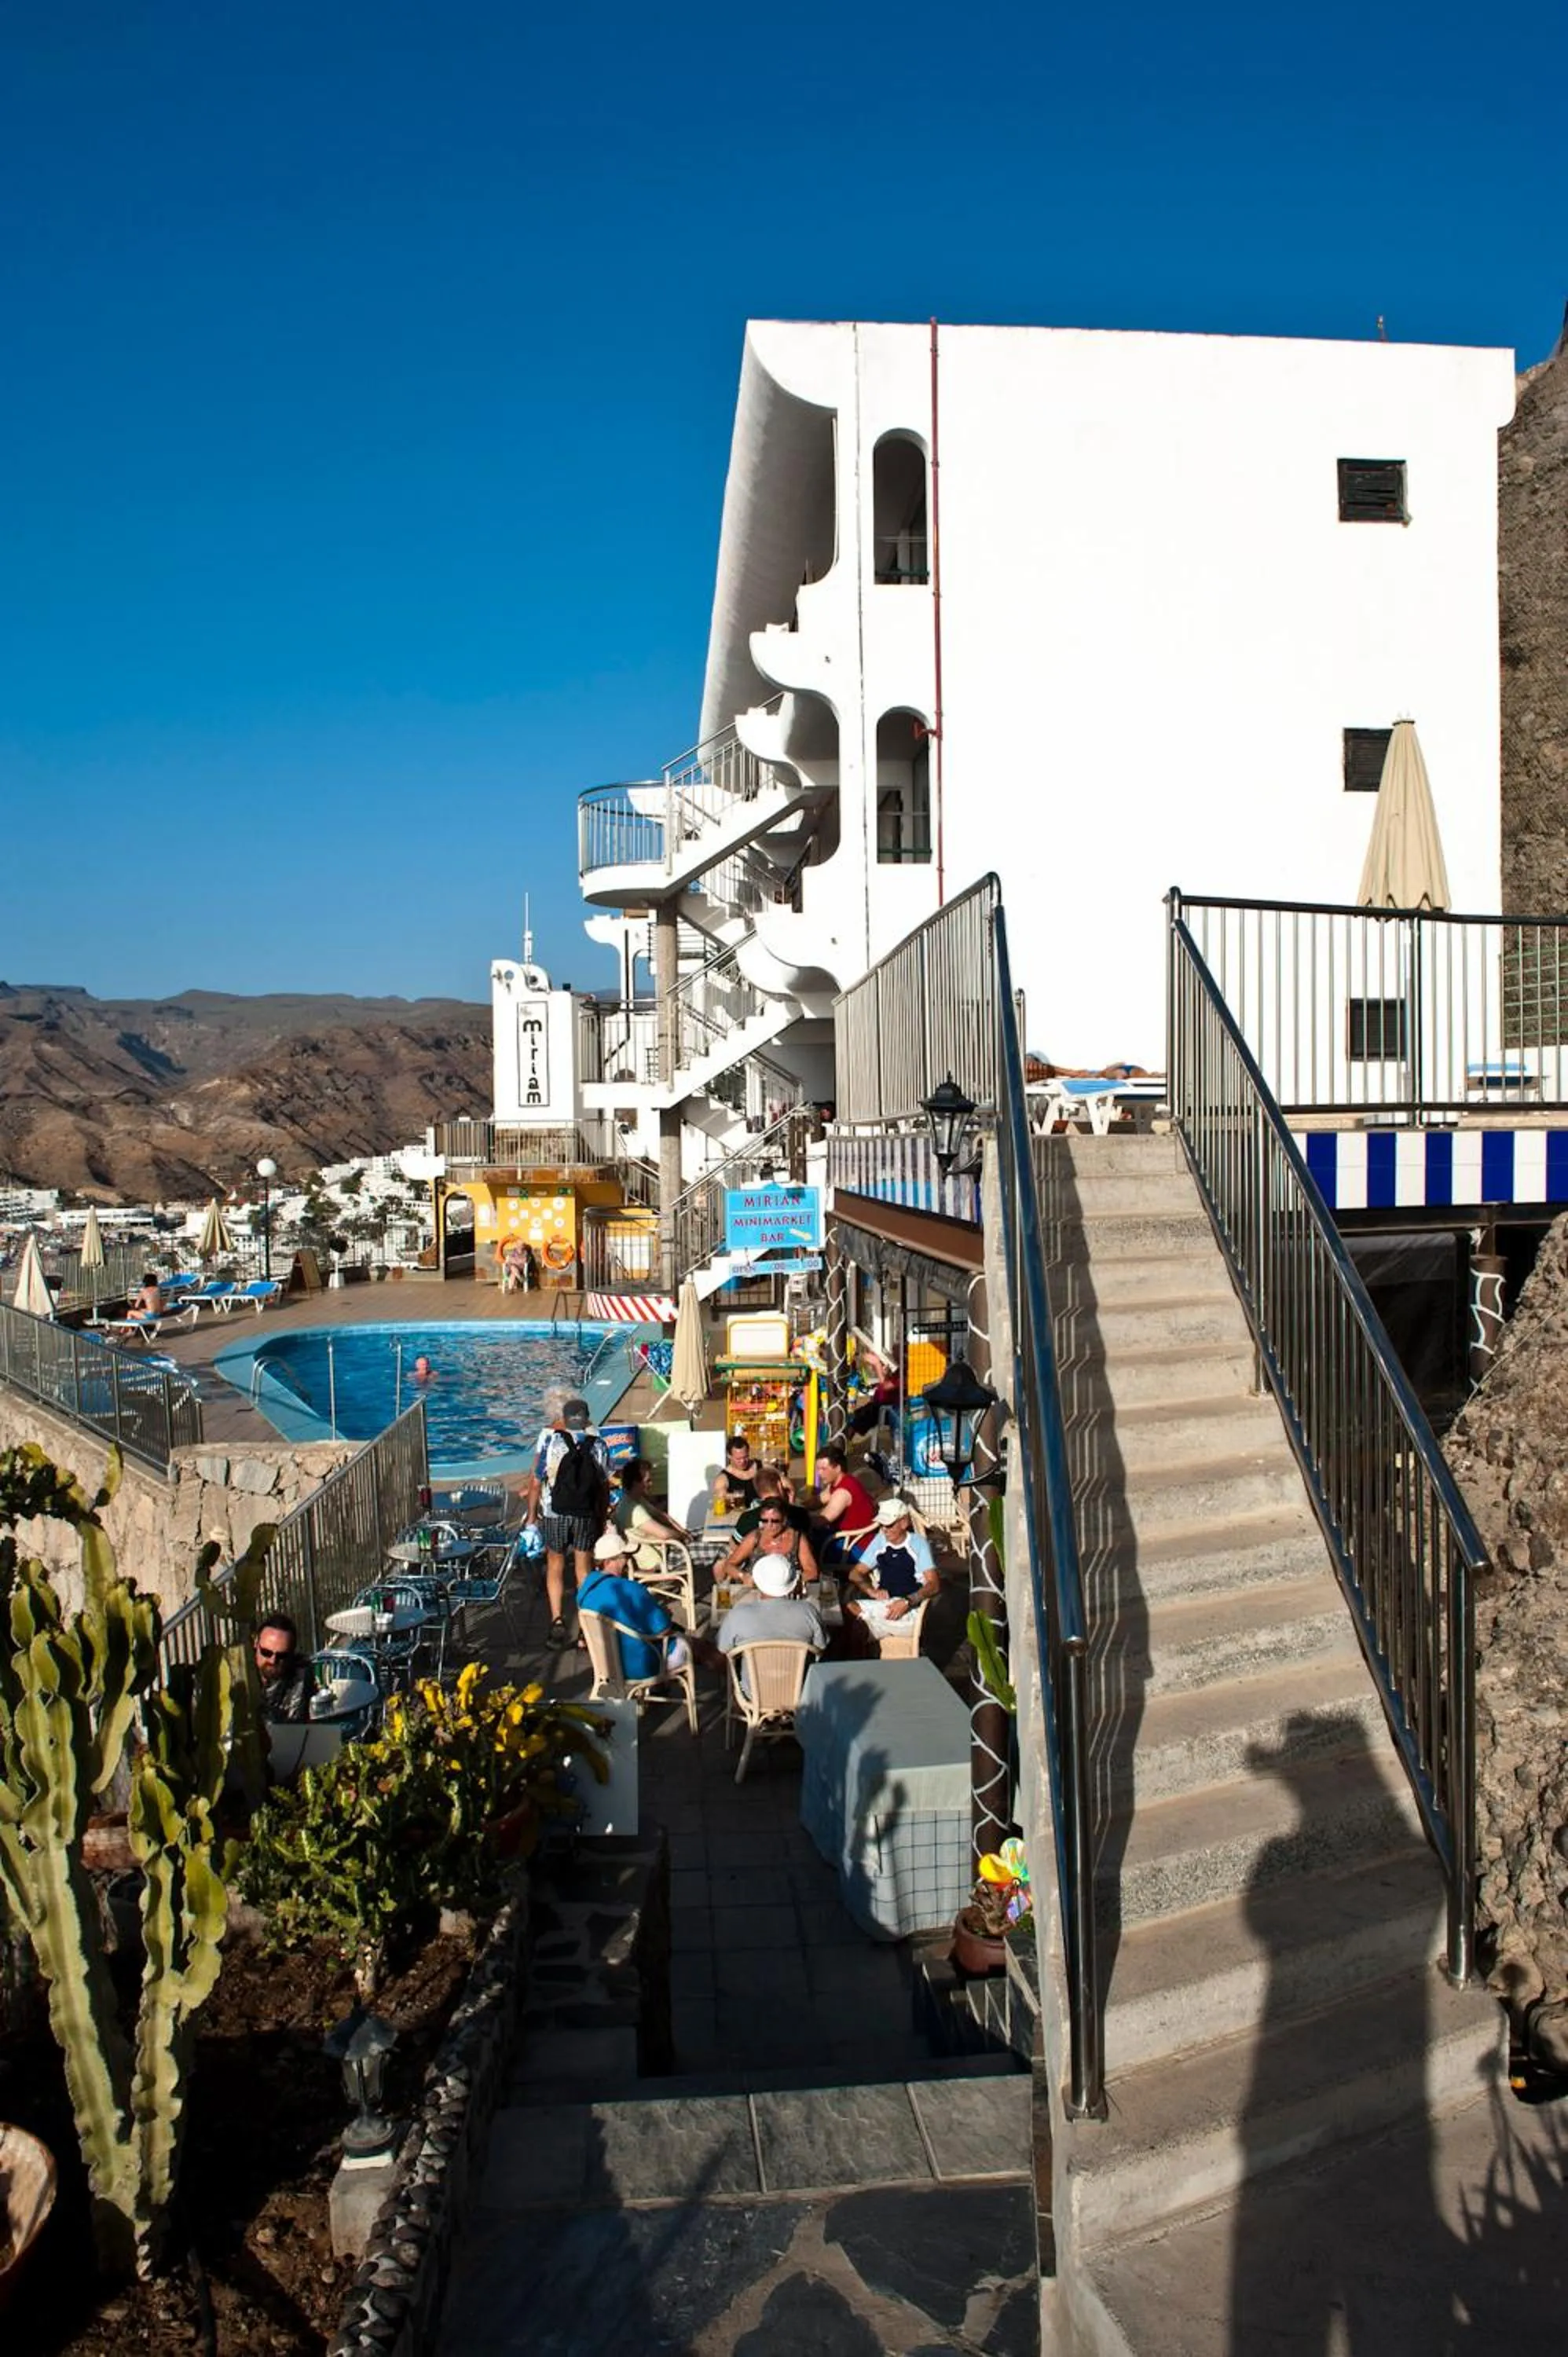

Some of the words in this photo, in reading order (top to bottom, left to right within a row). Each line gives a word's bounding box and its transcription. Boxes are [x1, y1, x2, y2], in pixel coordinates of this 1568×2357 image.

[522, 1019, 543, 1104] miriam
[735, 1215, 811, 1226] MINIMARKET
[760, 1233, 783, 1241] BAR
